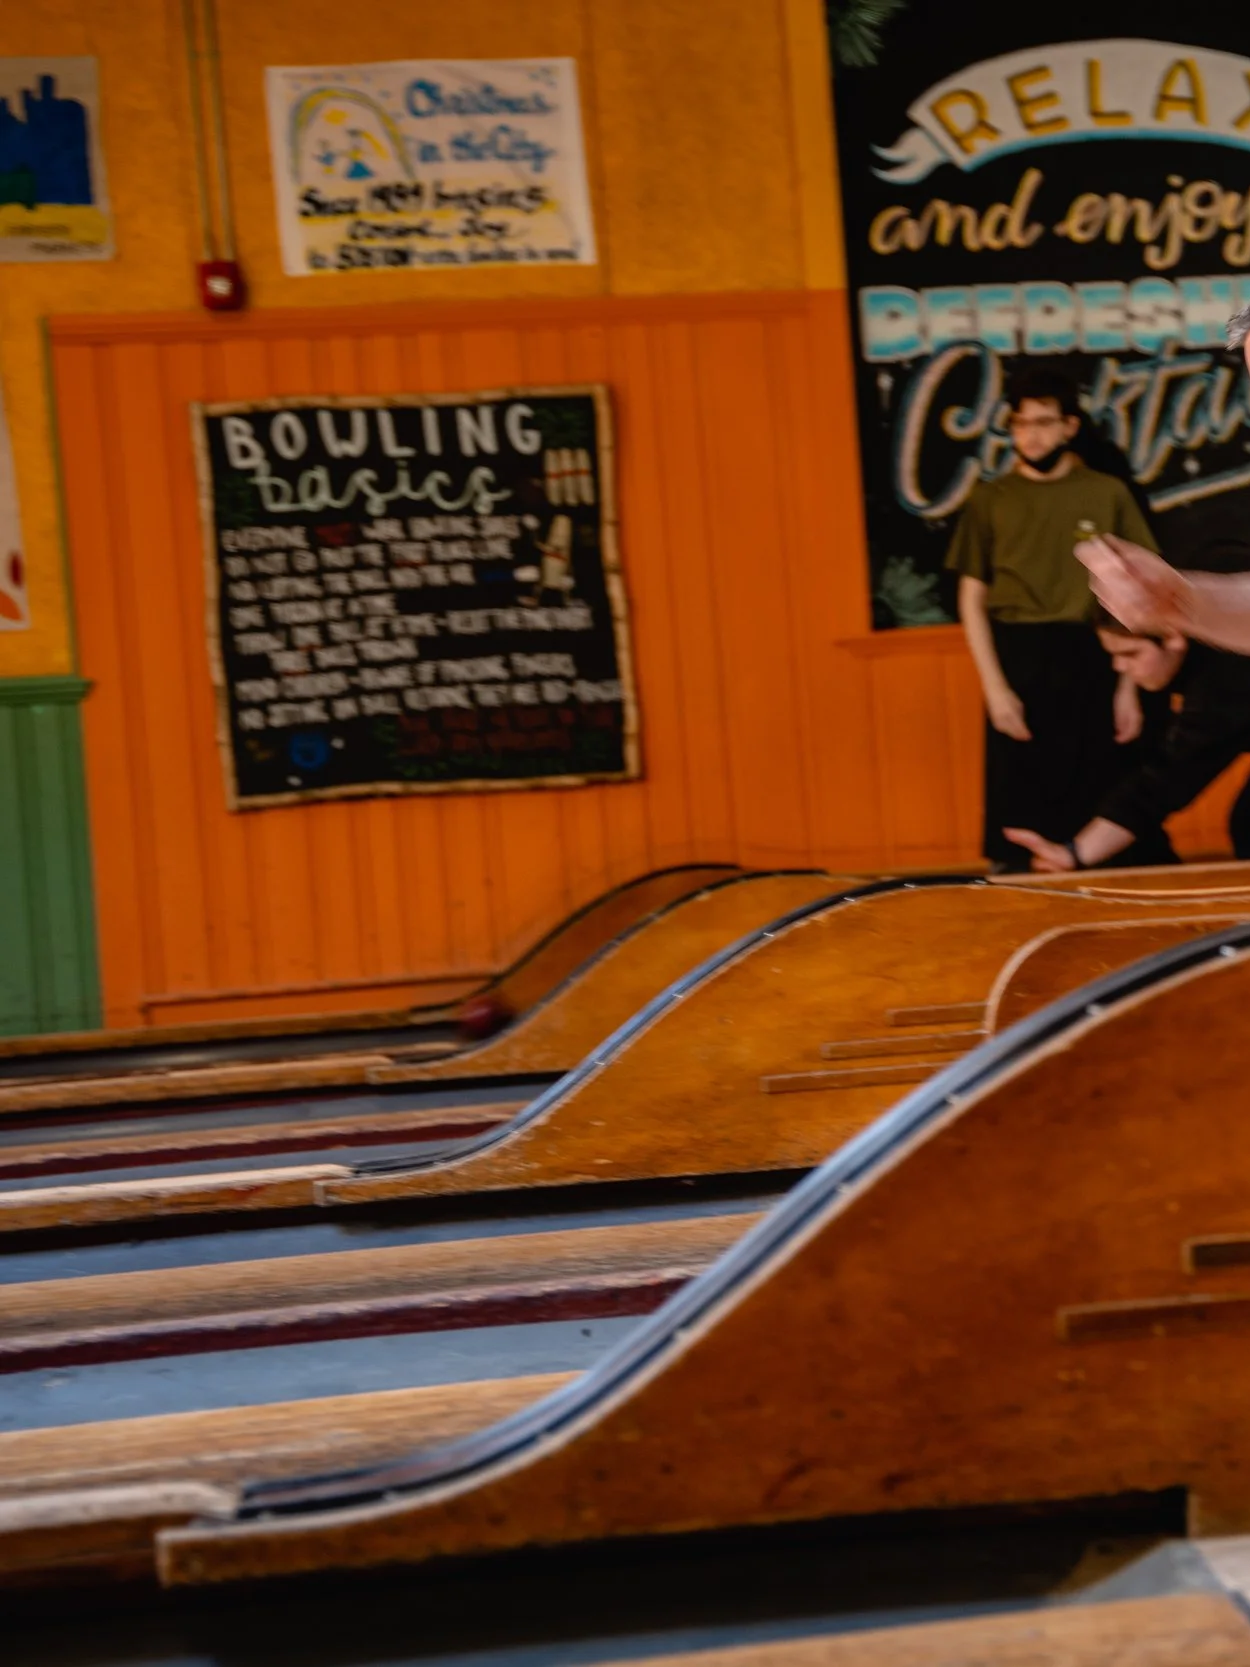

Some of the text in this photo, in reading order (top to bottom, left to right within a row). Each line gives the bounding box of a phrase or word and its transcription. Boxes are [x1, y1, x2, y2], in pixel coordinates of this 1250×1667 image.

[868, 167, 1045, 255] and
[221, 403, 542, 470] BOWLING
[248, 459, 513, 516] basics
